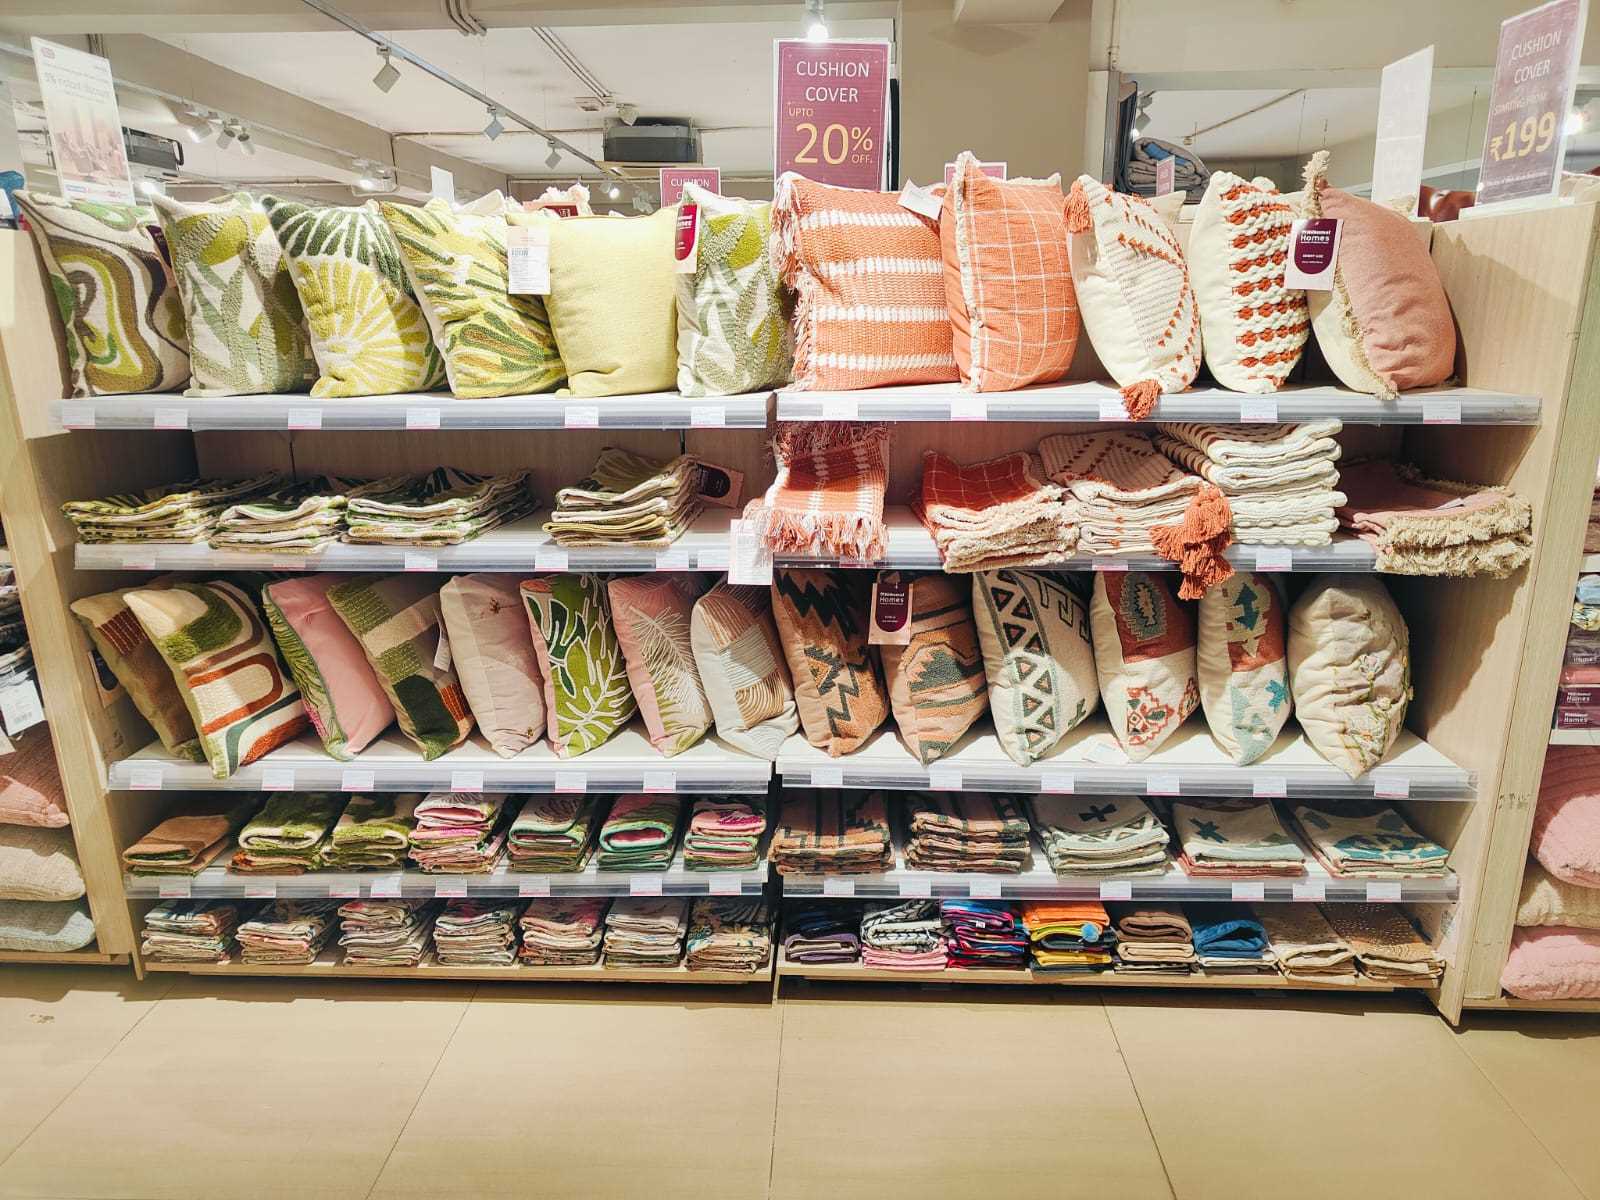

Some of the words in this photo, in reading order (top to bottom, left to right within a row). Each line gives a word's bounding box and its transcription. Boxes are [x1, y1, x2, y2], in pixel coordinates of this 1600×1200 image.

[1511, 29, 1562, 61] CUSHION
[796, 60, 870, 78] CUSHION
[1513, 59, 1551, 85] COVER
[805, 86, 859, 103] COVER
[788, 107, 814, 118] UPTO
[1489, 111, 1557, 162] ₹199
